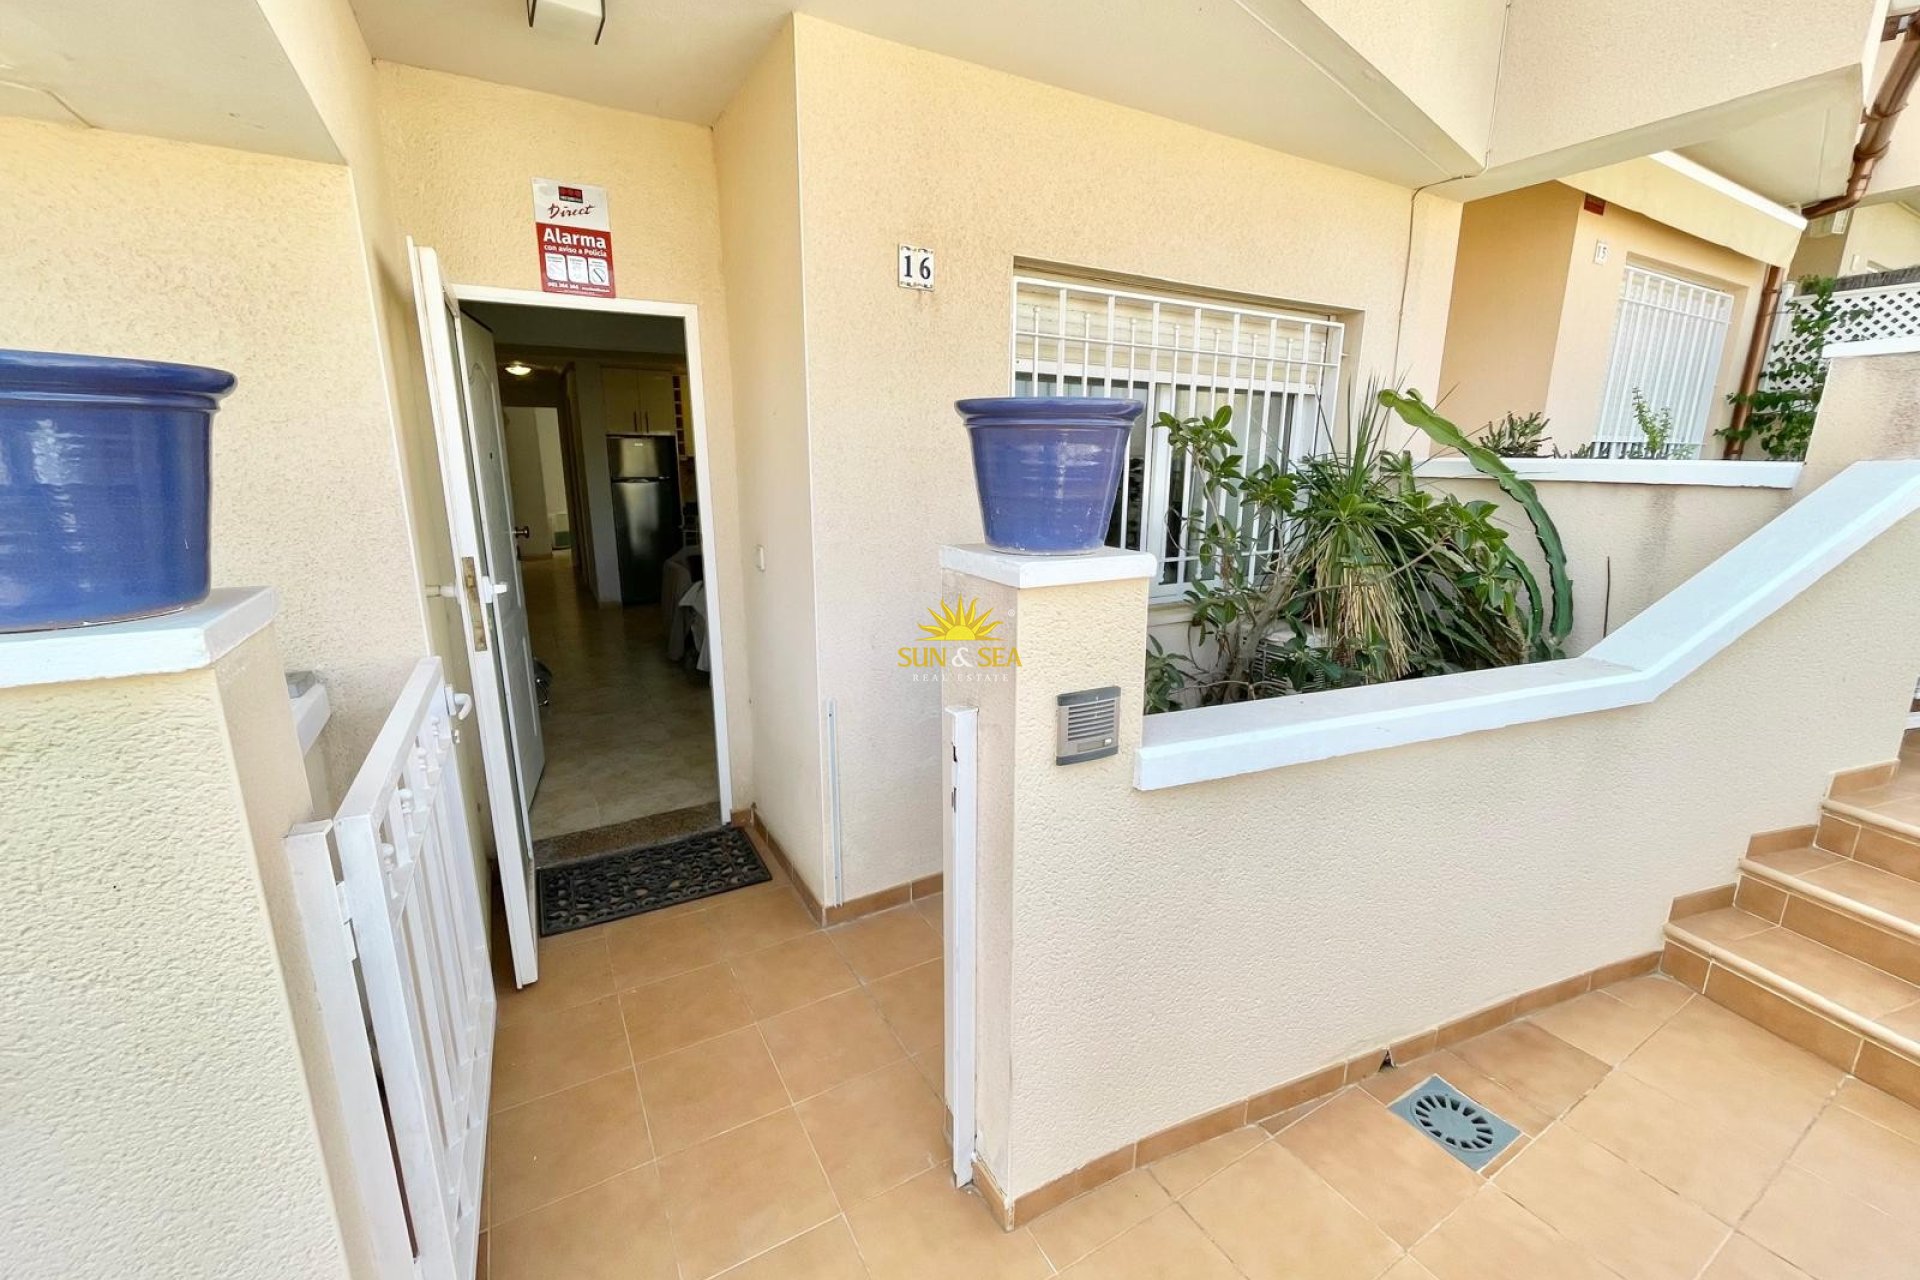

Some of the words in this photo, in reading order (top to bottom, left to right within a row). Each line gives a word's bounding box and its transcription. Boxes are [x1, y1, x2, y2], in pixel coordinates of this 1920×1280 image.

[548, 203, 595, 219] Direct
[544, 228, 606, 249] Alarma
[559, 246, 577, 254] aviso
[904, 255, 931, 280] 16
